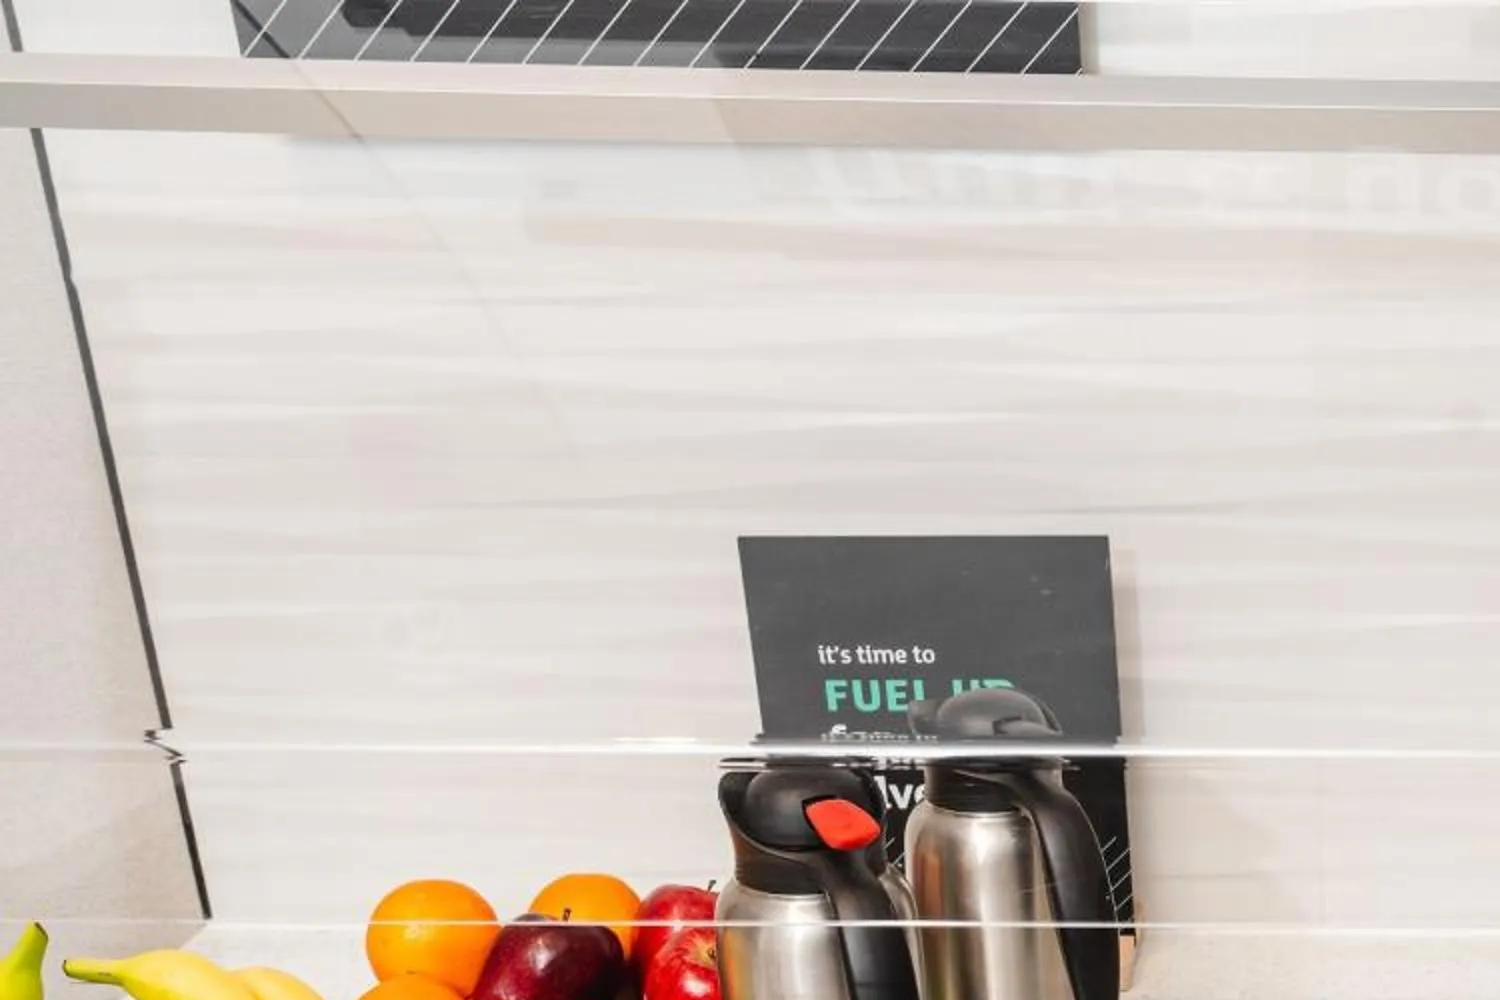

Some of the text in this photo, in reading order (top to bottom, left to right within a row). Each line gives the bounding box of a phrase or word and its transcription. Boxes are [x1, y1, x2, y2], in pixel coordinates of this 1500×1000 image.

[818, 646, 936, 665] it's time to
